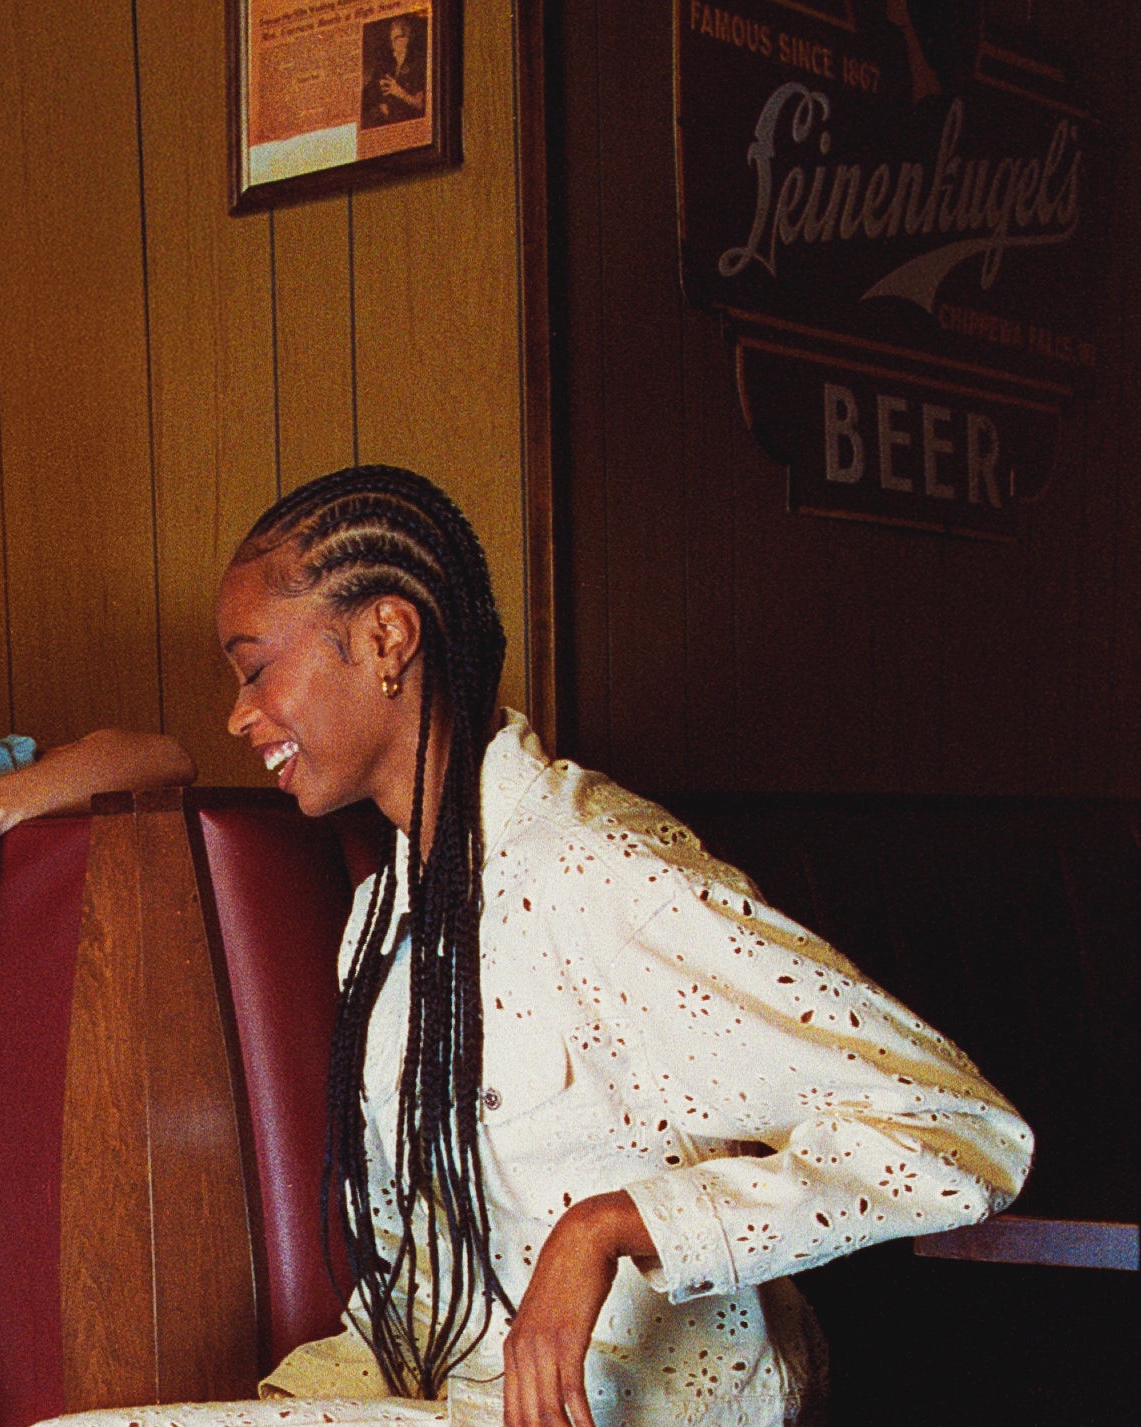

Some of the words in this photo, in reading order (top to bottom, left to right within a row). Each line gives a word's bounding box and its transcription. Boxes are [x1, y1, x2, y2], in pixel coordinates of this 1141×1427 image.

[690, 0, 772, 58] FAMOUS
[778, 31, 835, 80] SINCE
[718, 81, 1082, 291] Leinenkugel's
[824, 382, 1003, 510] BEER
